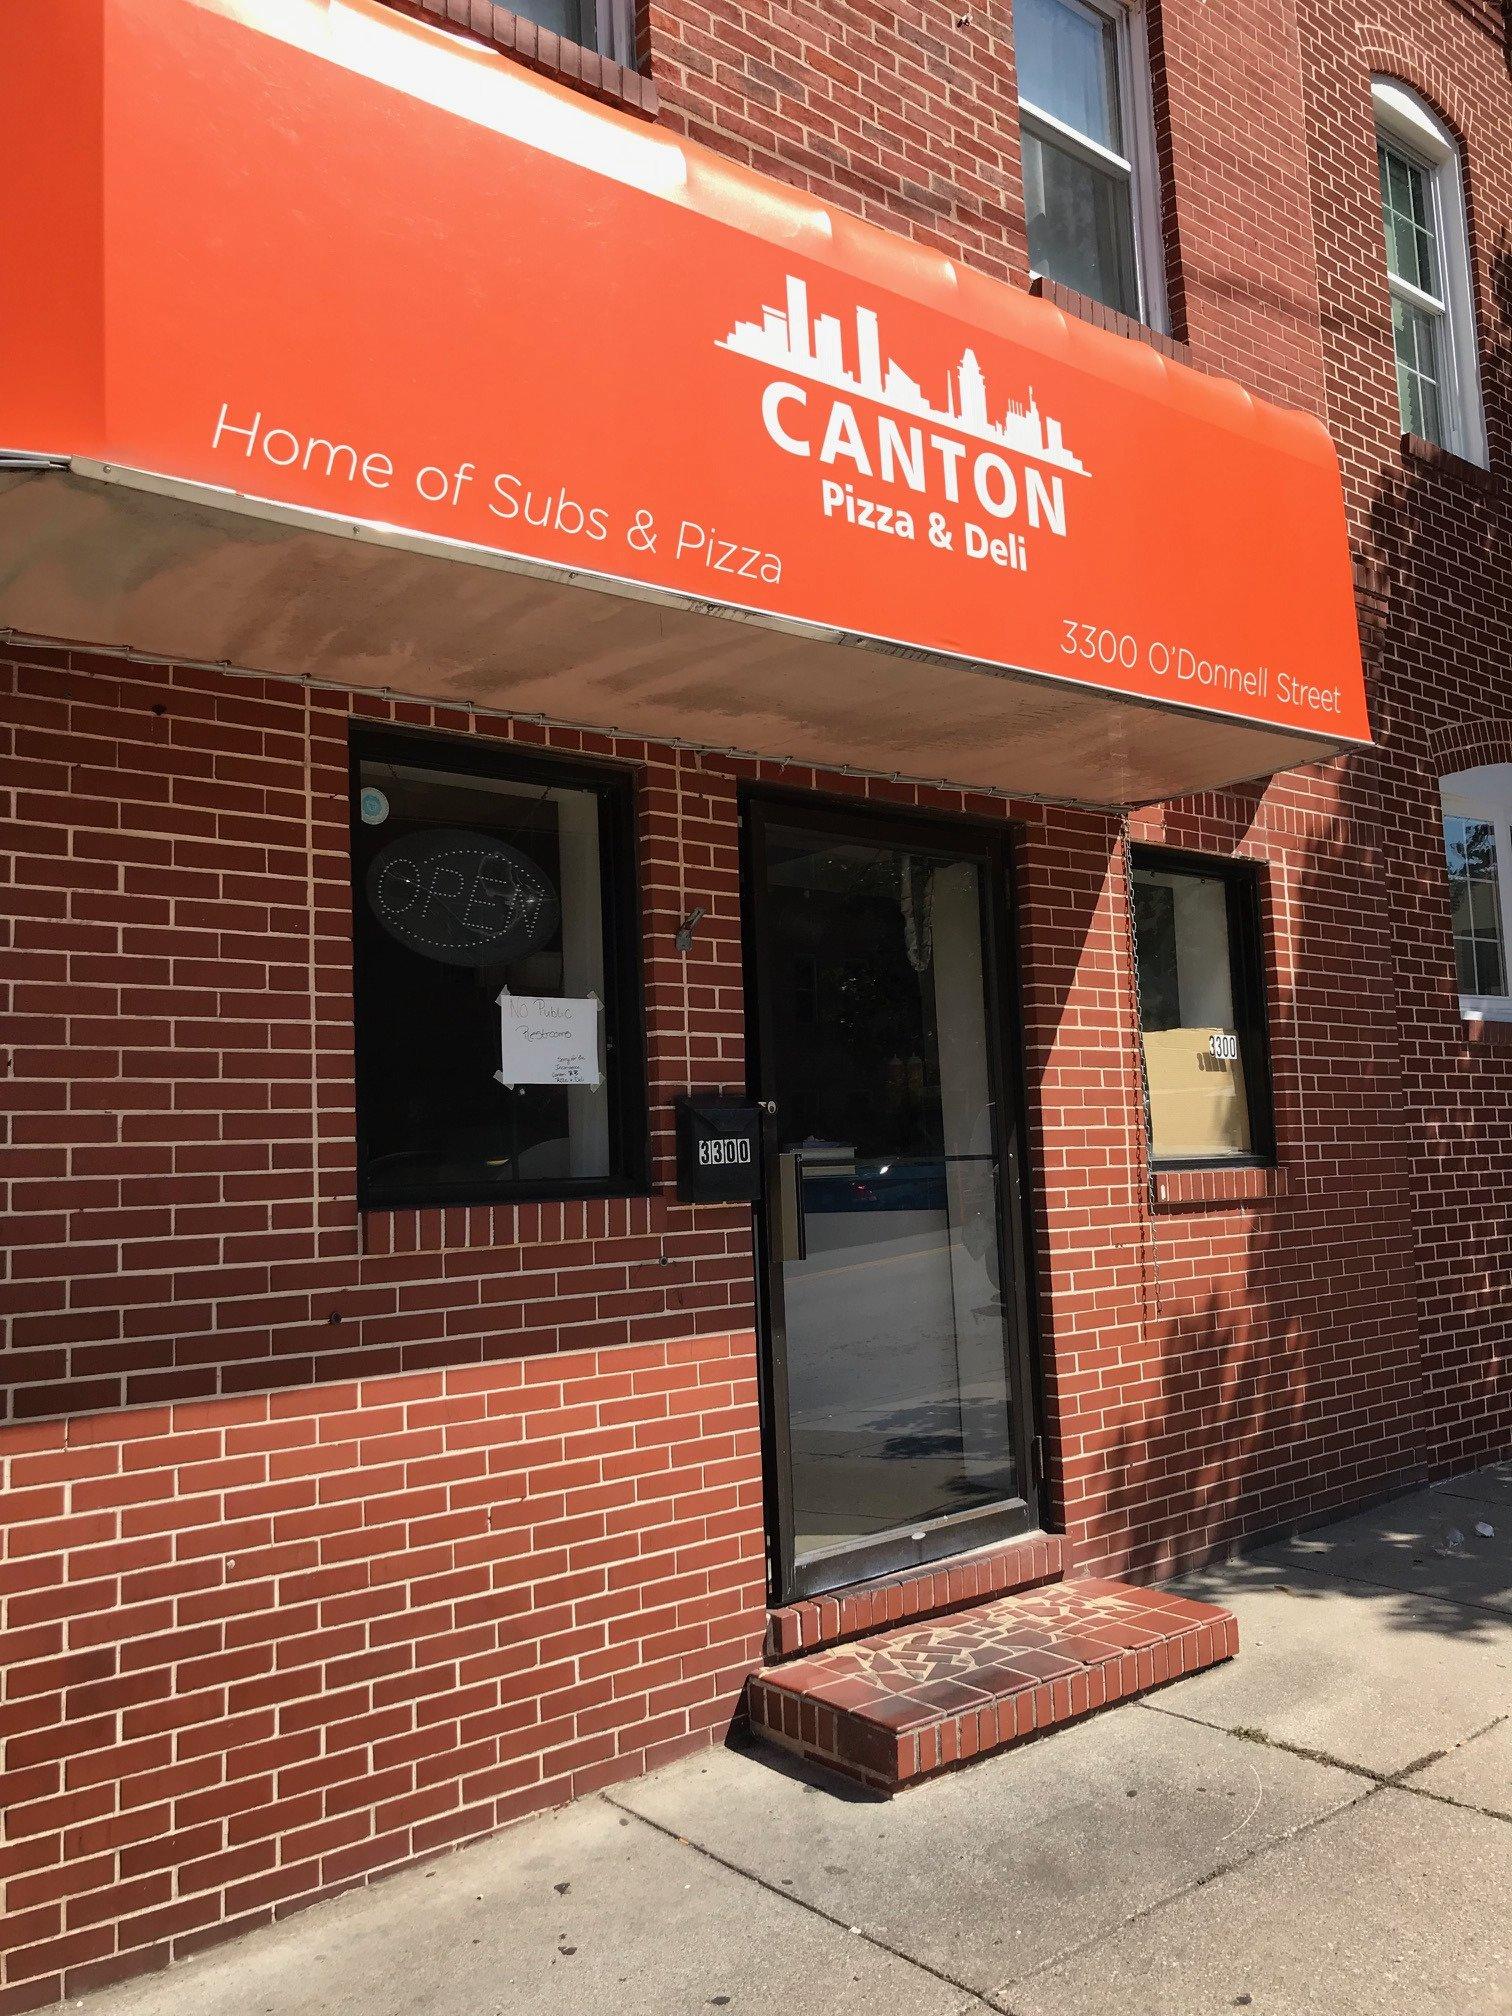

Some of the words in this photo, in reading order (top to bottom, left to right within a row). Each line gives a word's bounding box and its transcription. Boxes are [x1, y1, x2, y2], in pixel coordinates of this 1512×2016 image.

[211, 402, 394, 489] Home
[415, 462, 476, 506] of
[487, 472, 608, 541] Subs
[625, 508, 658, 554] &
[675, 519, 783, 584] Pizza
[761, 380, 1067, 538] CANTON
[821, 478, 916, 541] Pizza
[927, 511, 955, 552] &
[964, 521, 1028, 572] Deli
[1060, 619, 1138, 669] 3300
[1149, 641, 1268, 698] O'Donnell
[1275, 672, 1342, 714] Street
[378, 858, 545, 939] OPEN
[1208, 1034, 1237, 1058] 3300
[699, 1139, 750, 1165] 3300
